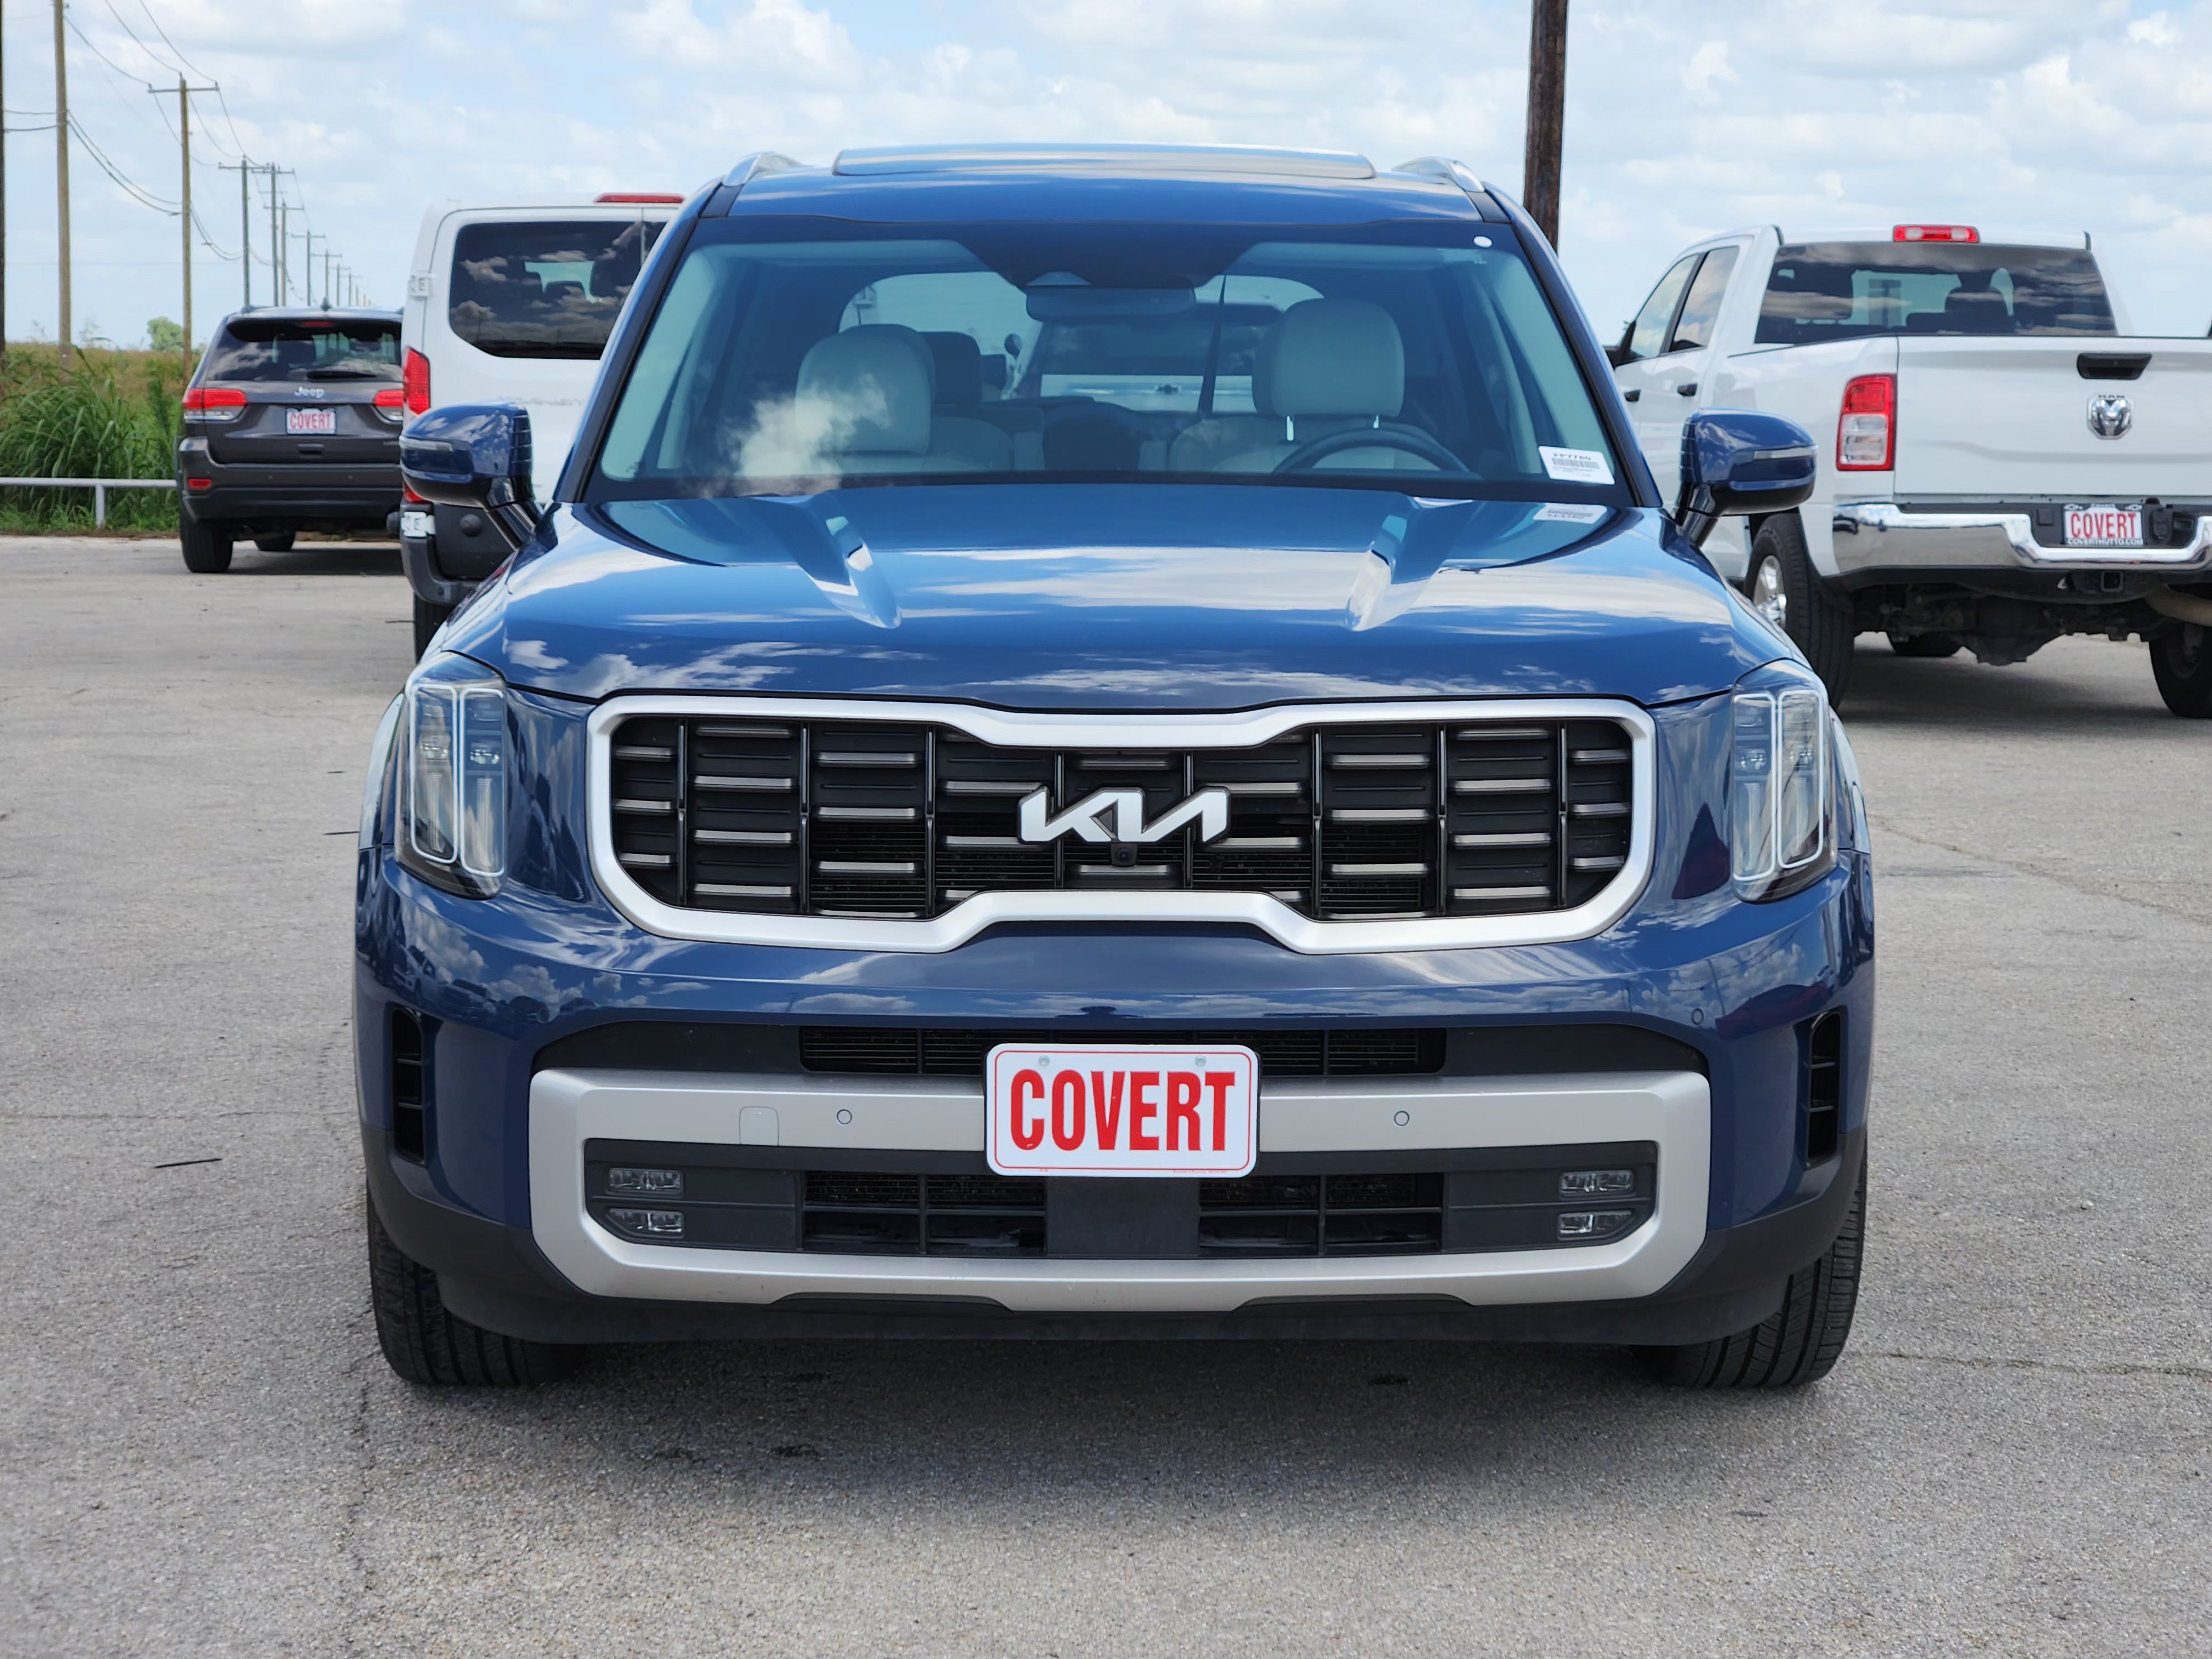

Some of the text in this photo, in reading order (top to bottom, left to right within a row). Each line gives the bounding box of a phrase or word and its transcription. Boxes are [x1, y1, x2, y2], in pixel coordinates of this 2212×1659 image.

[294, 386, 325, 398] Jeep
[290, 413, 331, 429] COVERT
[2070, 512, 2137, 539] COVERT
[1019, 786, 1230, 844] KIA
[1010, 1068, 1236, 1151] COVERT
